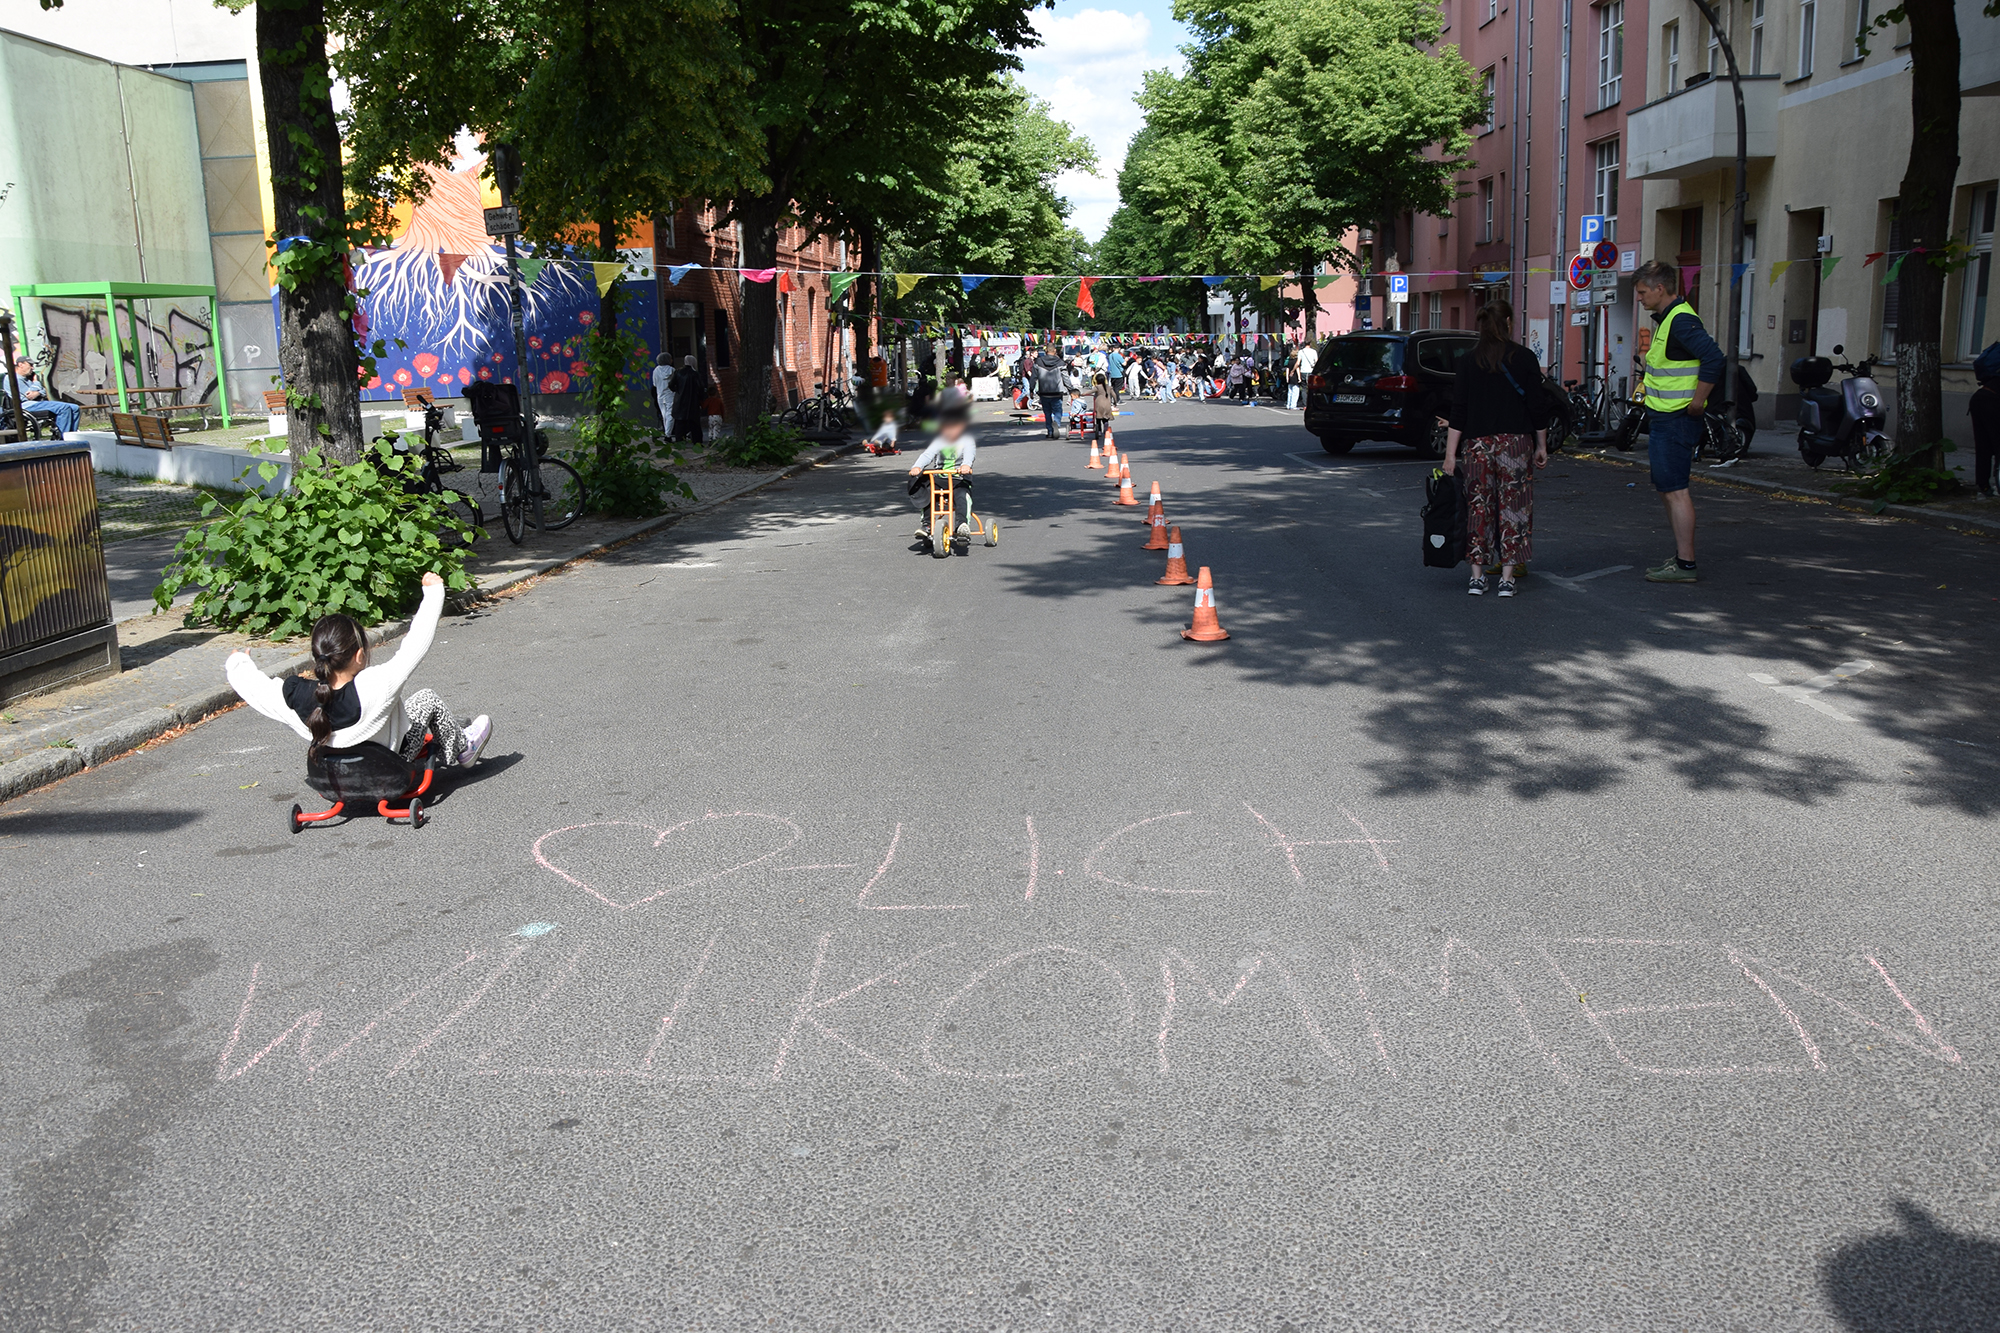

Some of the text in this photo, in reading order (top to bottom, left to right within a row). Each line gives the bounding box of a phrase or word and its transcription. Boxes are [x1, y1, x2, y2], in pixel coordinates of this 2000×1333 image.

[488, 212, 515, 221] Gehweg-
[490, 222, 515, 231] schäden
[1586, 219, 1599, 240] P
[1395, 278, 1404, 292] P
[216, 929, 1963, 1085] WILLKOMMEN
